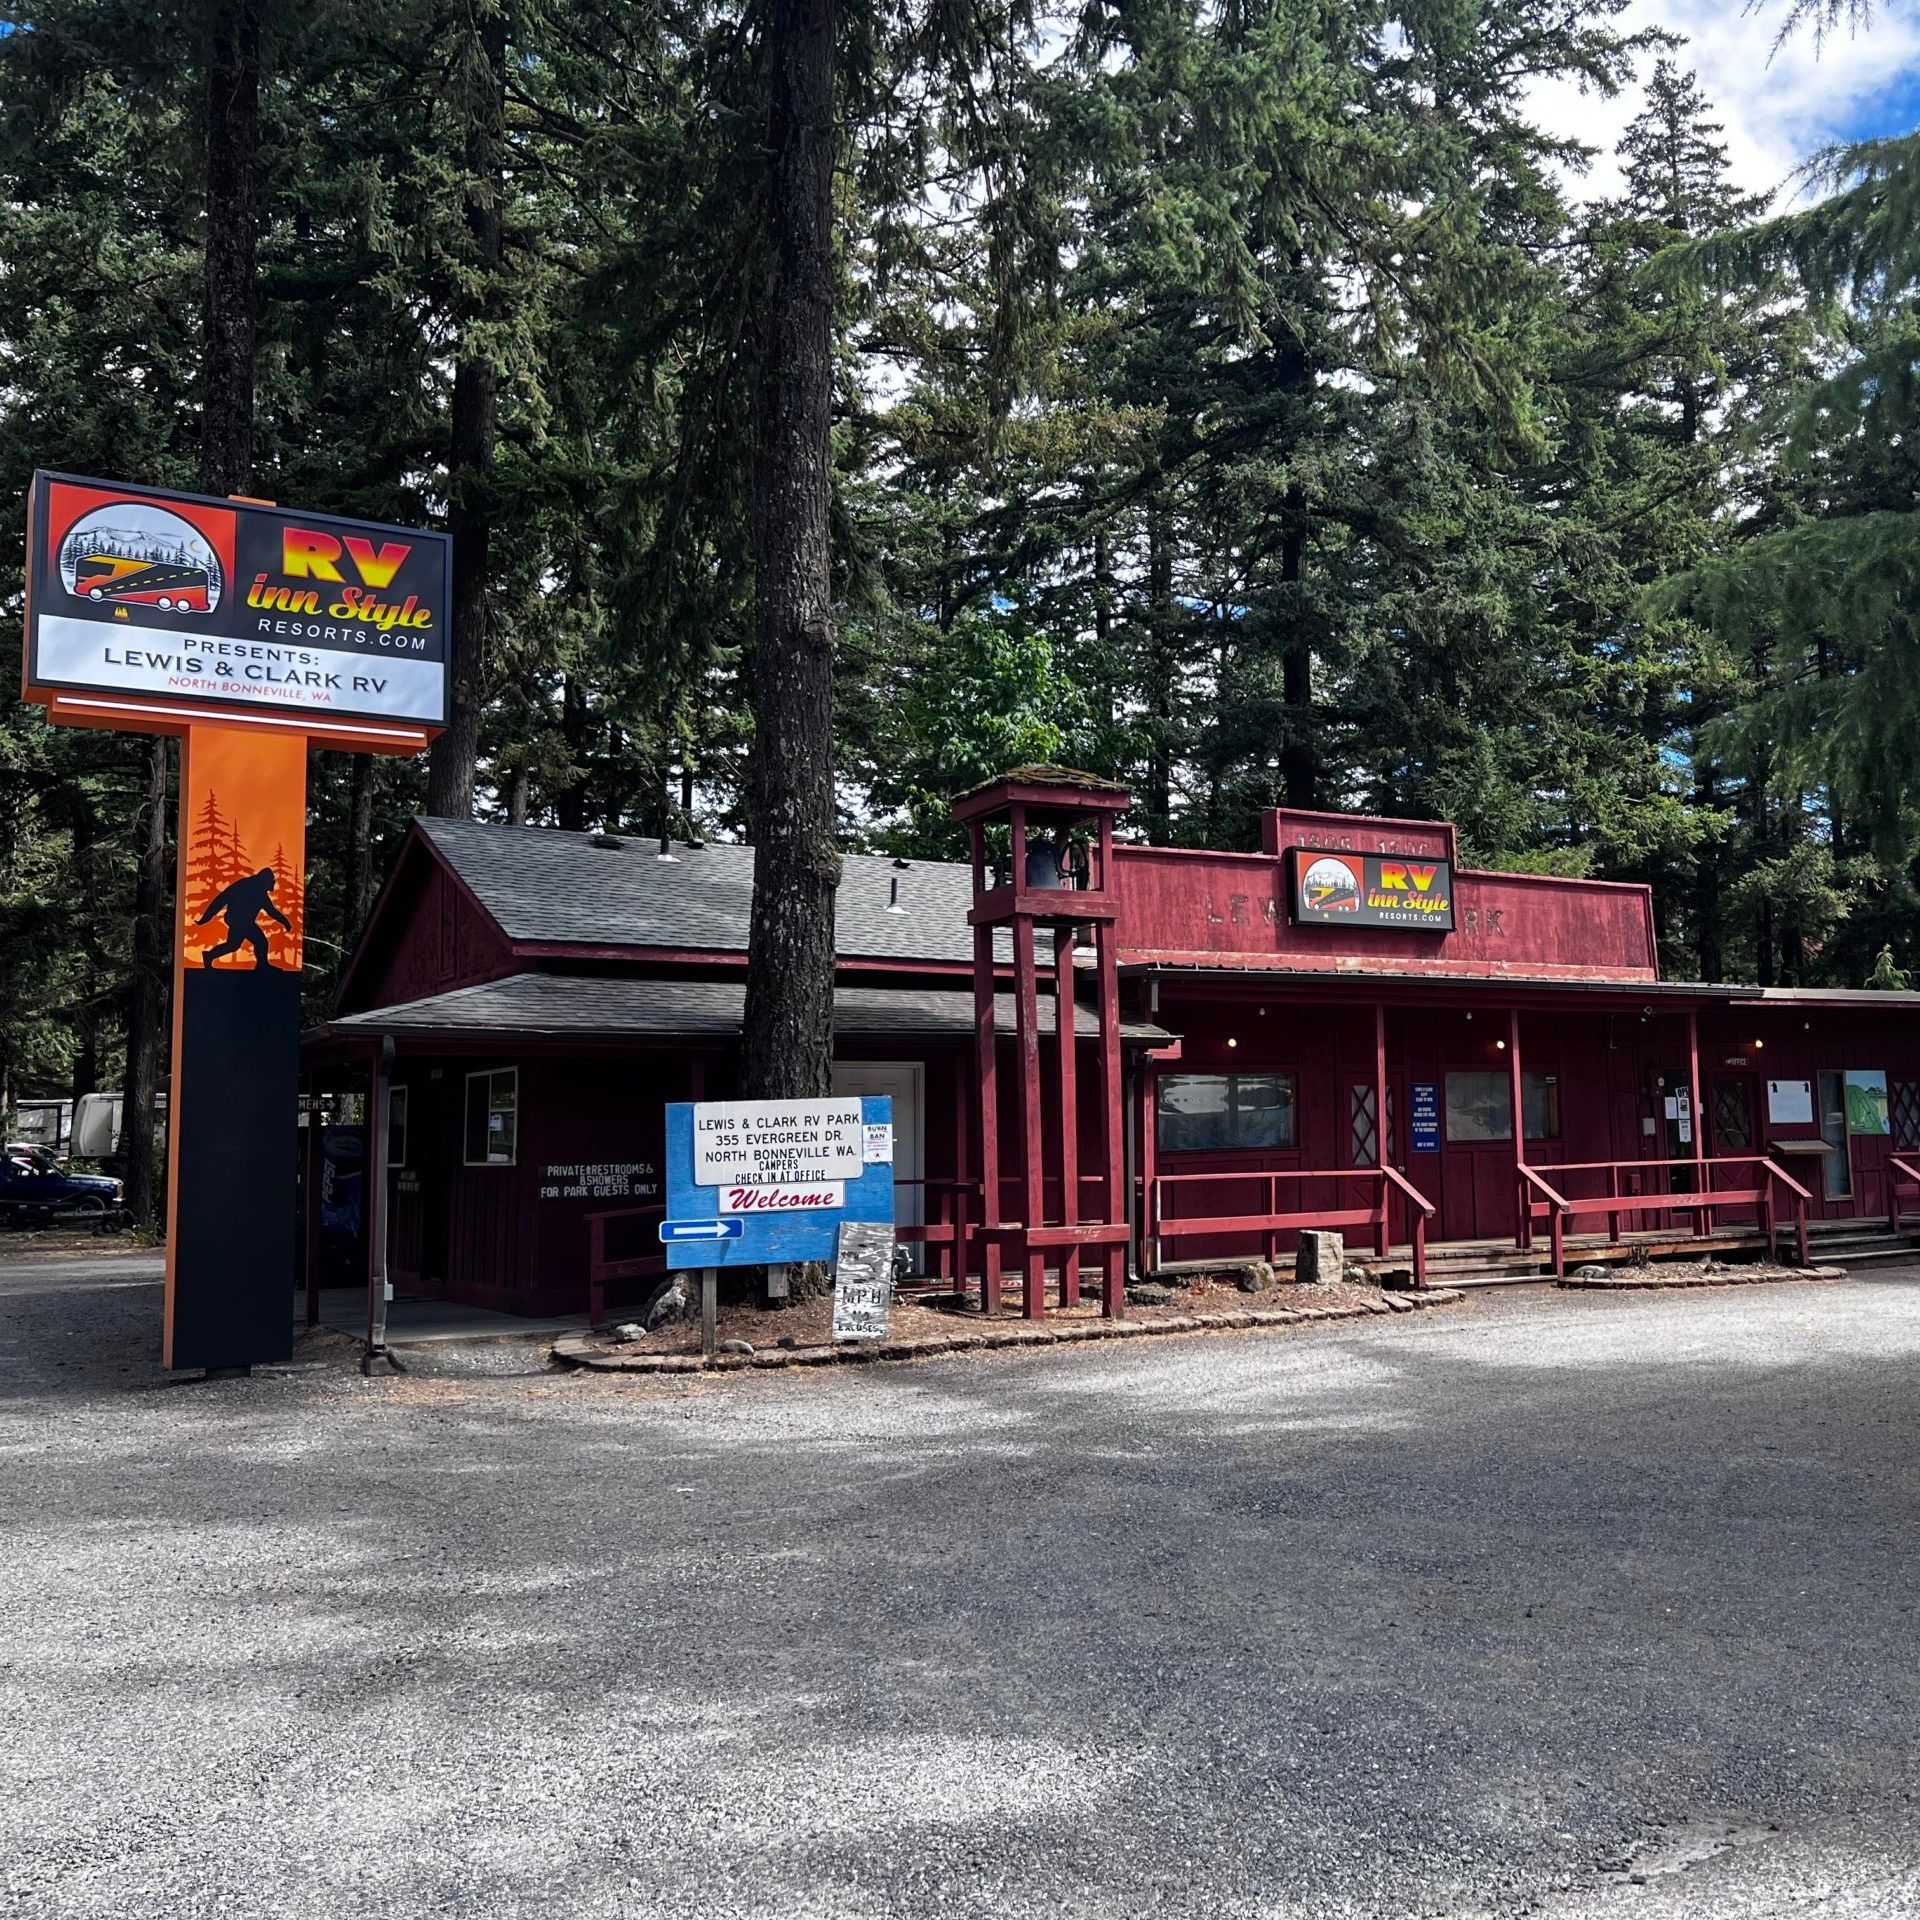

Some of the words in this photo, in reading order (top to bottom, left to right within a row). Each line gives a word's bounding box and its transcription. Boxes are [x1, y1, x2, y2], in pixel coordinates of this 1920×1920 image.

[282, 526, 412, 589] RV
[247, 573, 323, 615] inn
[328, 586, 433, 631] Style
[258, 618, 426, 650] RESORTS.COM
[184, 639, 320, 665] PRESENTS:
[104, 647, 203, 673] LEWIS
[215, 661, 233, 677] &
[244, 665, 342, 691] CLARK
[353, 676, 389, 694] RV
[168, 676, 216, 690] NORTH
[222, 682, 306, 700] BONNEVILLE,
[312, 692, 331, 702] WA
[1381, 862, 1437, 891] RV
[1206, 894, 1282, 927] LEW
[1367, 887, 1400, 908] inn
[1402, 891, 1450, 914] Style
[1379, 912, 1441, 922] RESORTS.COM
[699, 1118, 735, 1131] LEWIS
[742, 1118, 750, 1129] &
[757, 1116, 798, 1128] CLARK
[804, 1115, 820, 1126] RV
[827, 1114, 860, 1125] PARK
[716, 1134, 739, 1146] 355
[746, 1131, 818, 1145] EVERGREEN
[825, 1130, 844, 1141] DR.
[705, 1150, 747, 1163] NORTH
[754, 1147, 830, 1160] BONNEVILLE
[836, 1145, 857, 1157] WA.
[759, 1159, 799, 1172] CAMPERS
[547, 1164, 586, 1176] PRIVATE
[591, 1163, 644, 1175] RESTROOMS
[735, 1172, 763, 1185] CHECK
[767, 1172, 776, 1183] IN
[780, 1171, 793, 1182] AT
[794, 1170, 826, 1182] OFFICE
[541, 1186, 559, 1198] FOR
[563, 1186, 589, 1197] PARK
[593, 1184, 630, 1197] GUESTS
[634, 1184, 657, 1195] ONLY
[728, 1188, 834, 1210] Welcome
